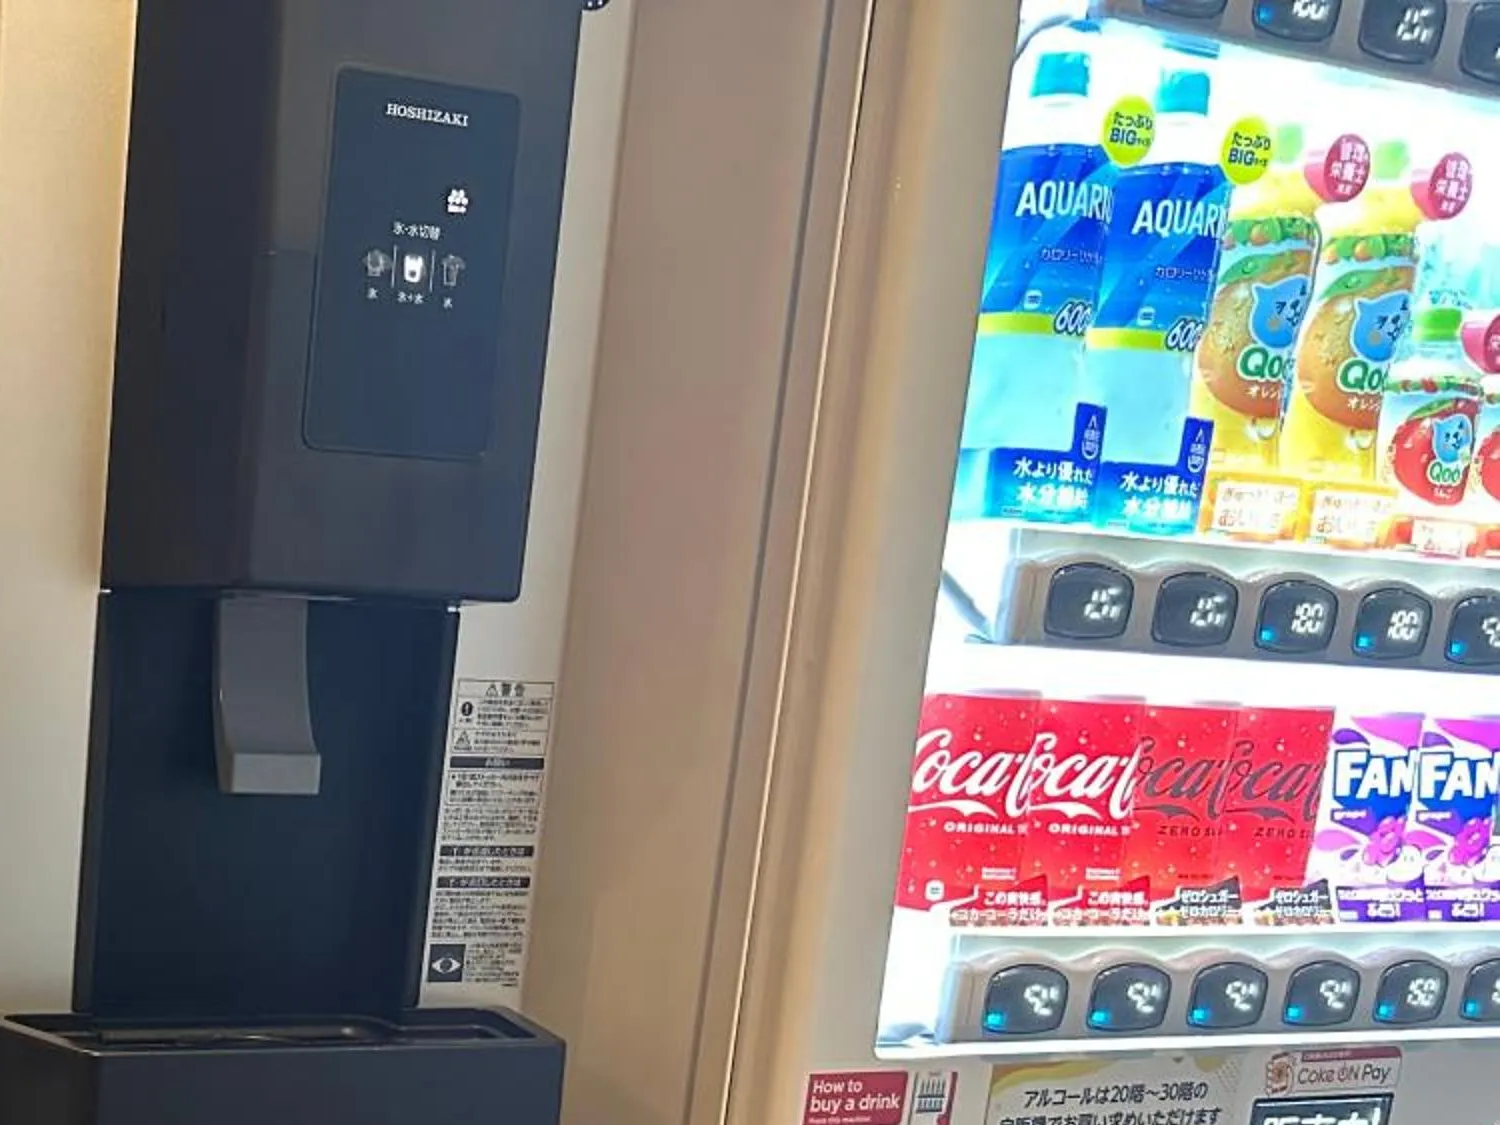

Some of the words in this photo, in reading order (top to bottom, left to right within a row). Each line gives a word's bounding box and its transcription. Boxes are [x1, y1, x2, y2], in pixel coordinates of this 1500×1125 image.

[386, 103, 469, 127] HOSHIZAKI
[1113, 111, 1153, 130] たっぷり
[1232, 131, 1271, 150] たっぷり
[1429, 463, 1461, 485] Qoo
[944, 822, 1015, 834] ORIGINAL
[1049, 822, 1118, 836] ORIGINAL
[1298, 1068, 1334, 1085] Coke
[1362, 1064, 1391, 1083] Pay
[813, 1080, 844, 1093] How
[847, 1080, 863, 1092] to
[810, 1096, 841, 1114] buy
[845, 1098, 854, 1110] a
[859, 1093, 900, 1110] drink
